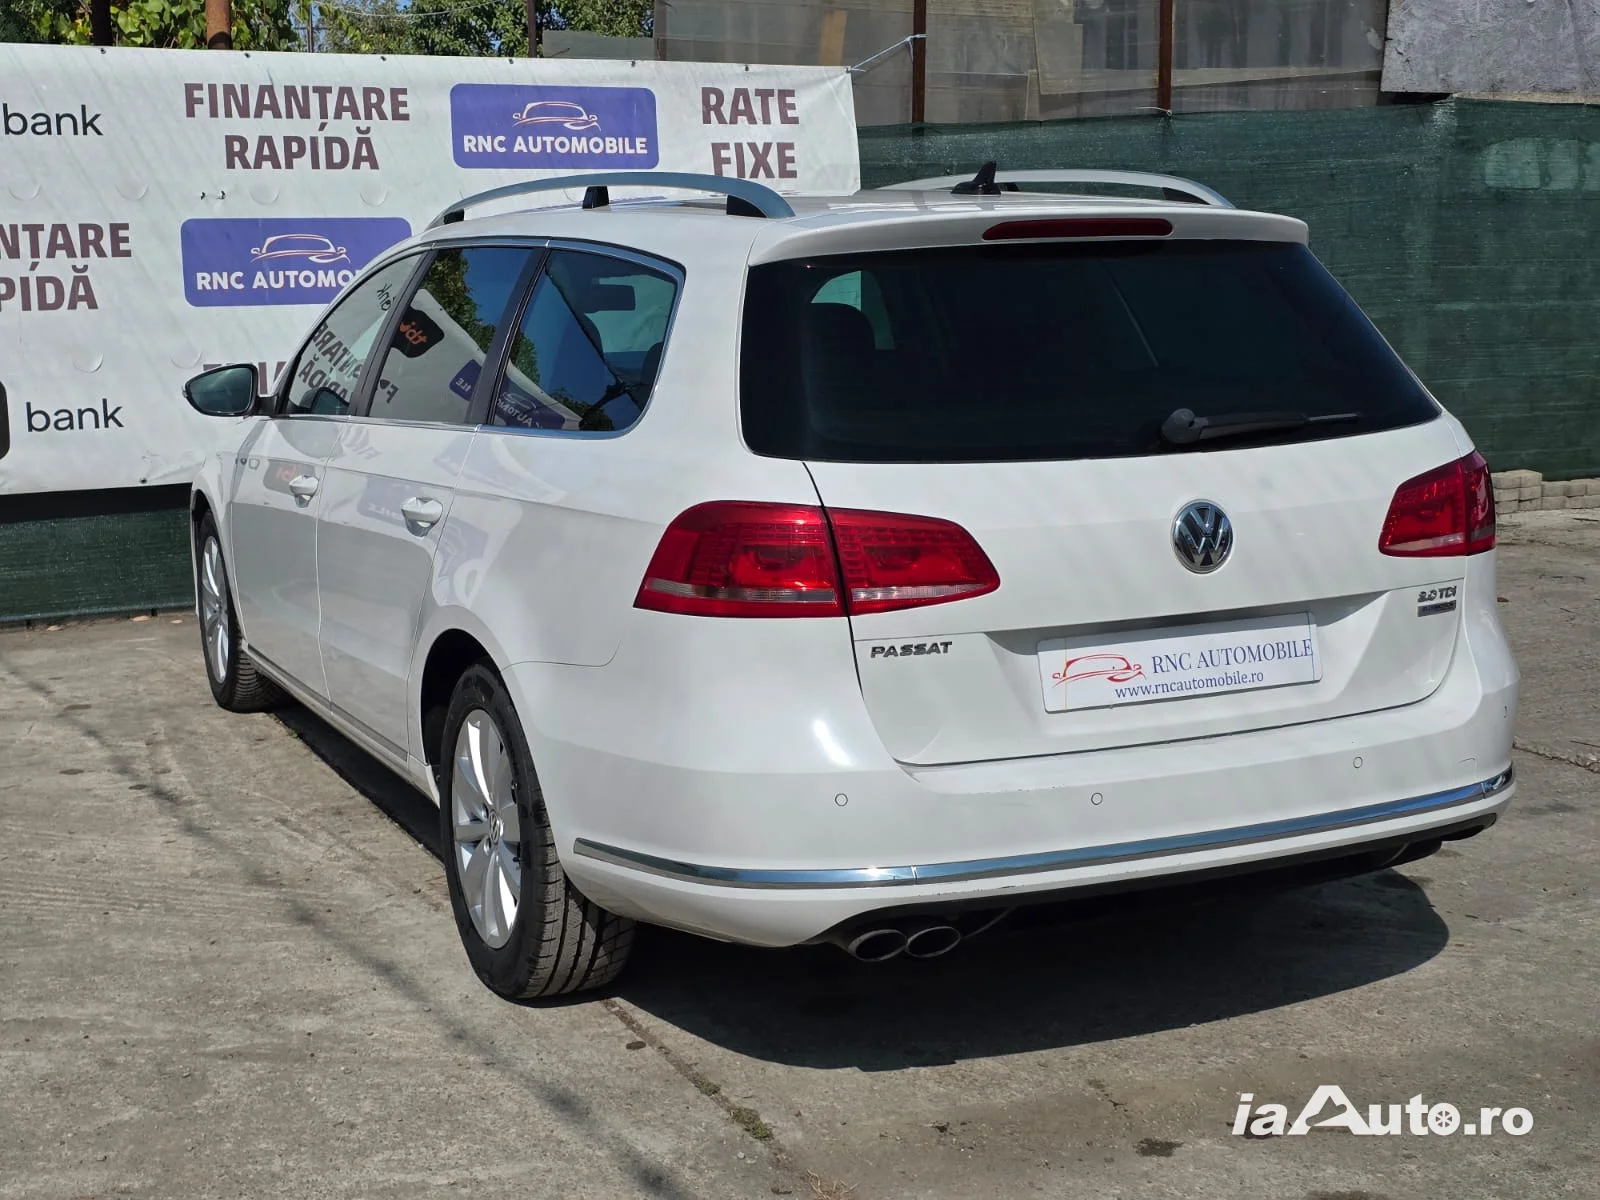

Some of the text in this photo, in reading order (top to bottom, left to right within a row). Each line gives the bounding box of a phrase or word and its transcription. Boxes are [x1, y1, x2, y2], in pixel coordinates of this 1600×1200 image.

[2, 103, 104, 136] bank
[701, 87, 800, 125] RATE
[463, 135, 648, 154] RNC AUTOMOBILE
[711, 142, 798, 179] FIXE
[196, 269, 362, 290] RNC AUTOMO
[26, 398, 124, 432] bank
[870, 641, 953, 659] PASSAT
[1151, 638, 1313, 674] RNC AUTOMOBILE
[1115, 671, 1265, 699] www.rncautomobile.ro
